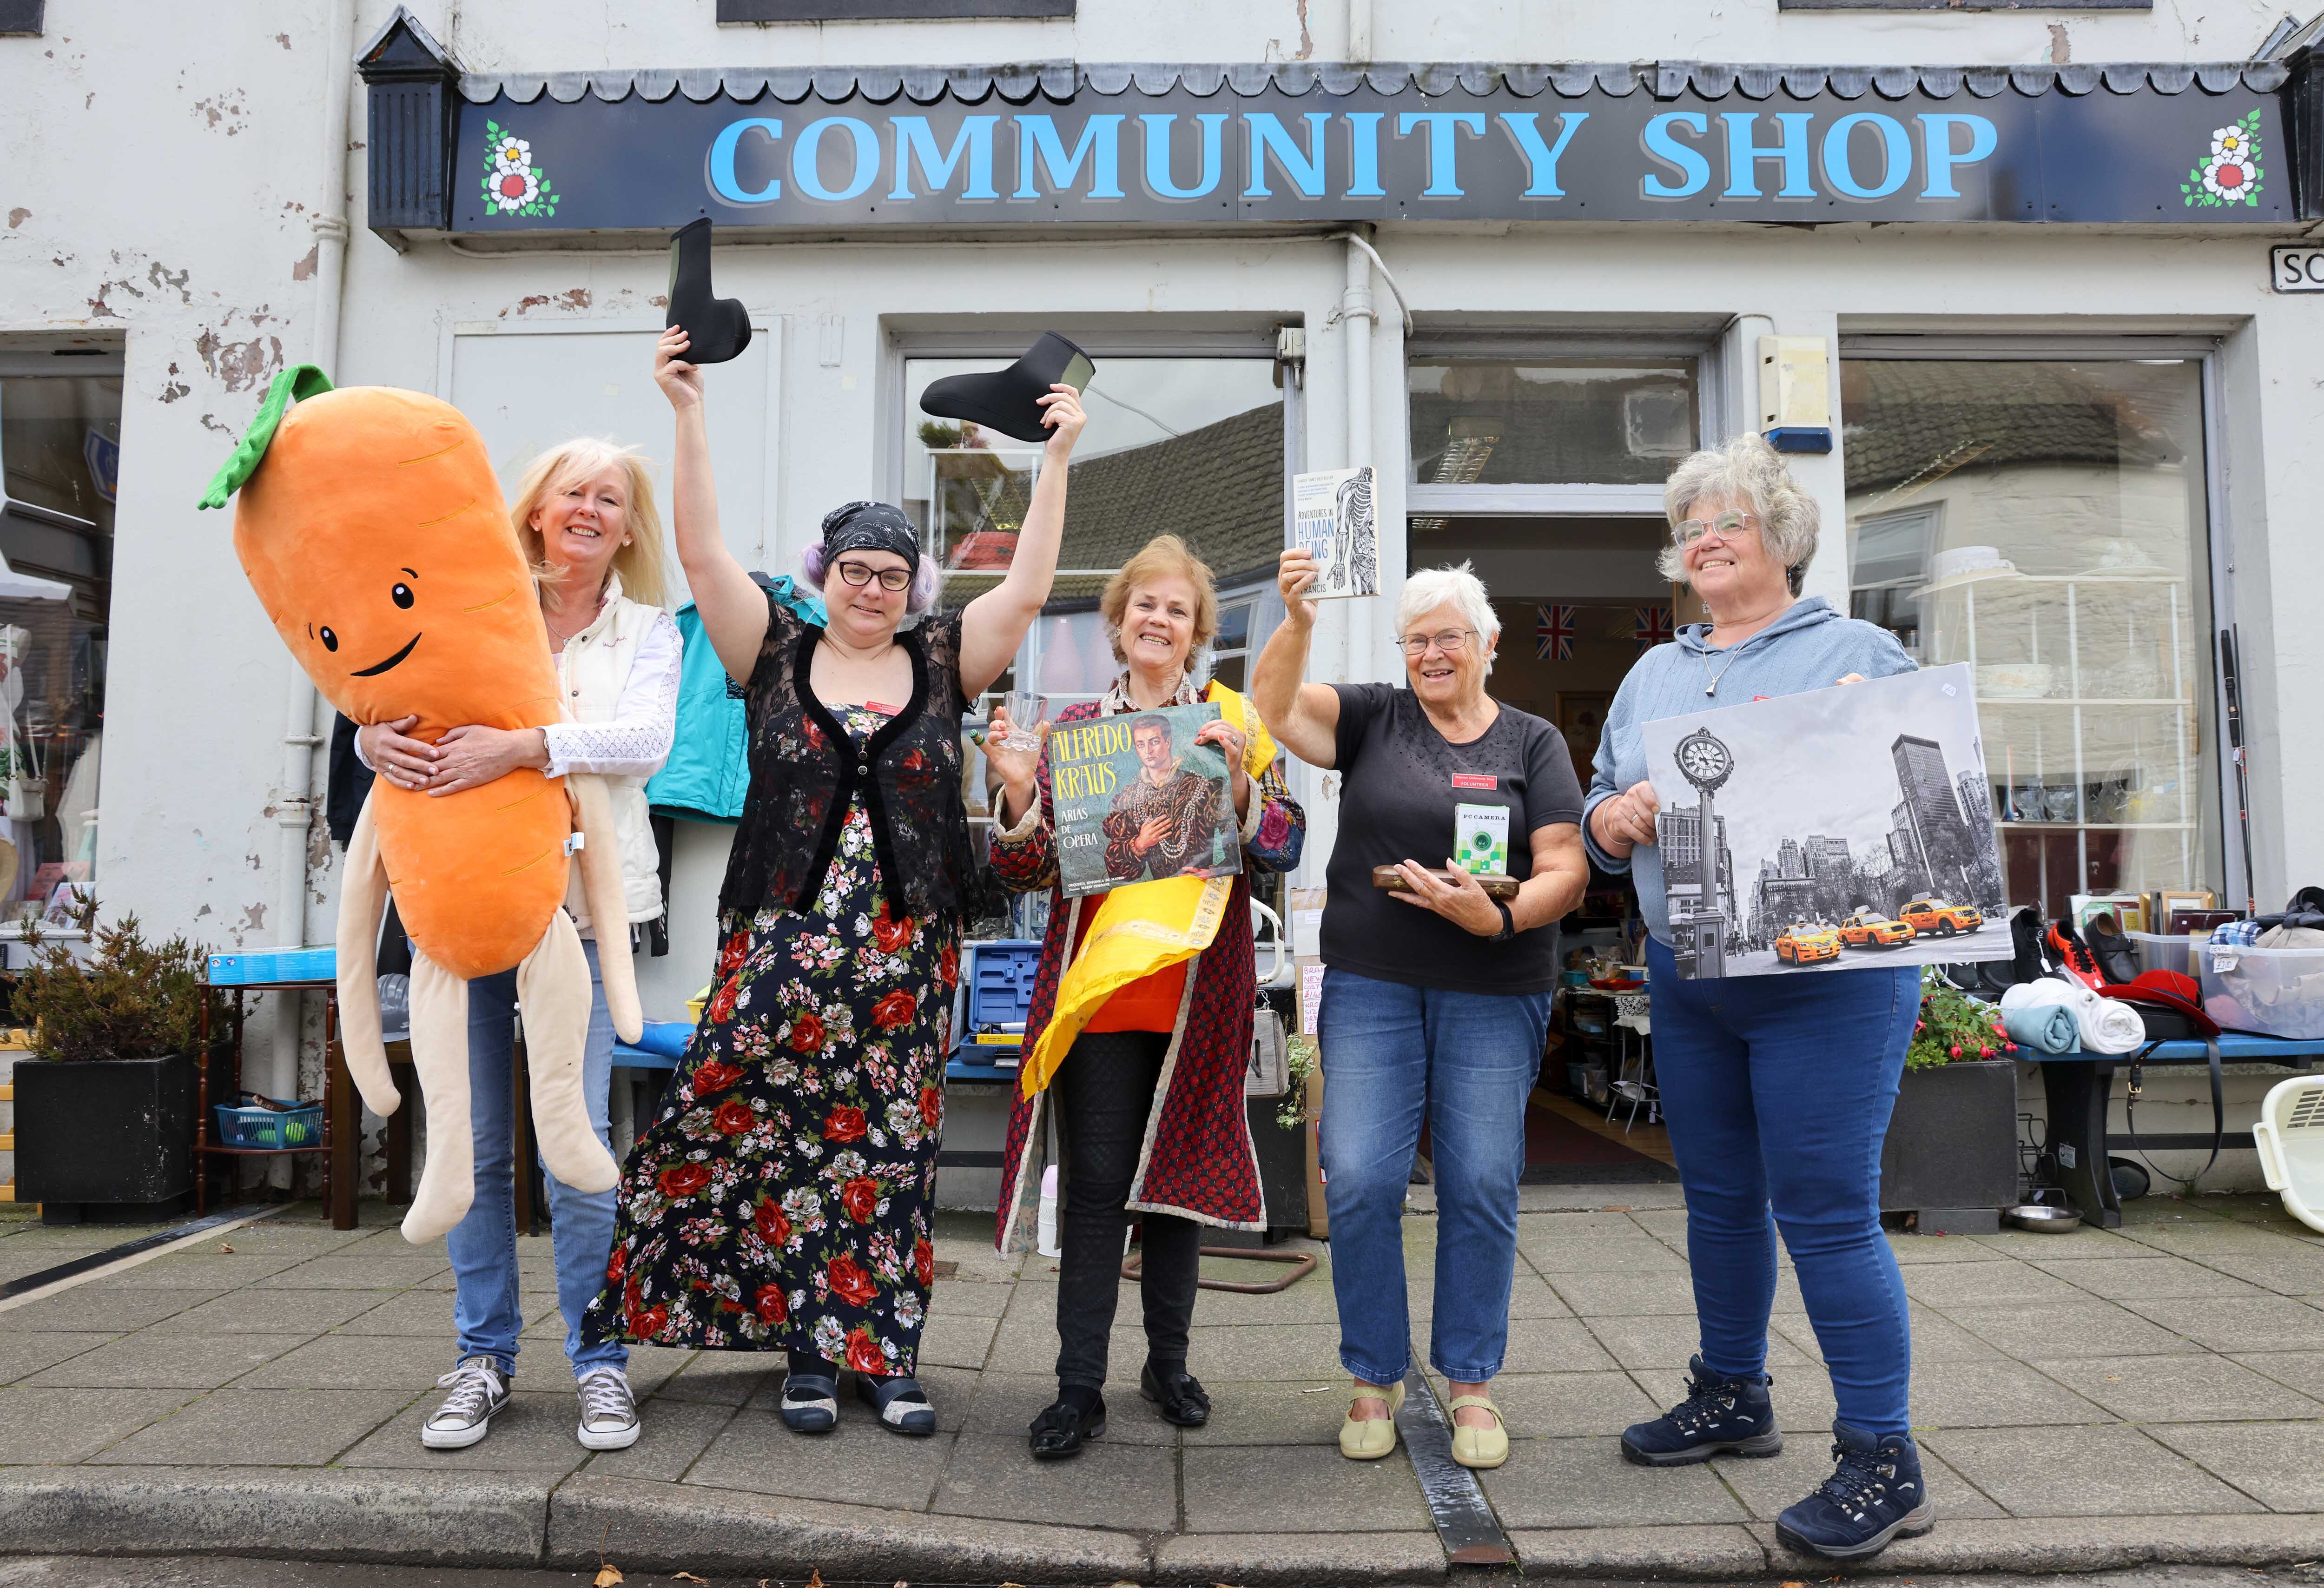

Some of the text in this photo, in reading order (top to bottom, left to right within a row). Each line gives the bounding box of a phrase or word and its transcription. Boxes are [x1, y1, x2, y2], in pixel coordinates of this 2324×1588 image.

[706, 112, 1998, 205] COMMUNITY SHOP
[1298, 509, 1327, 520] ADVENTURES
[1298, 518, 1334, 540] HUMAN
[1051, 722, 1132, 763] ALFREDO
[1054, 761, 1116, 801] KRAUS
[1061, 807, 1088, 822] ARIAS
[1061, 825, 1071, 834] DE
[1063, 833, 1098, 848] OPERA
